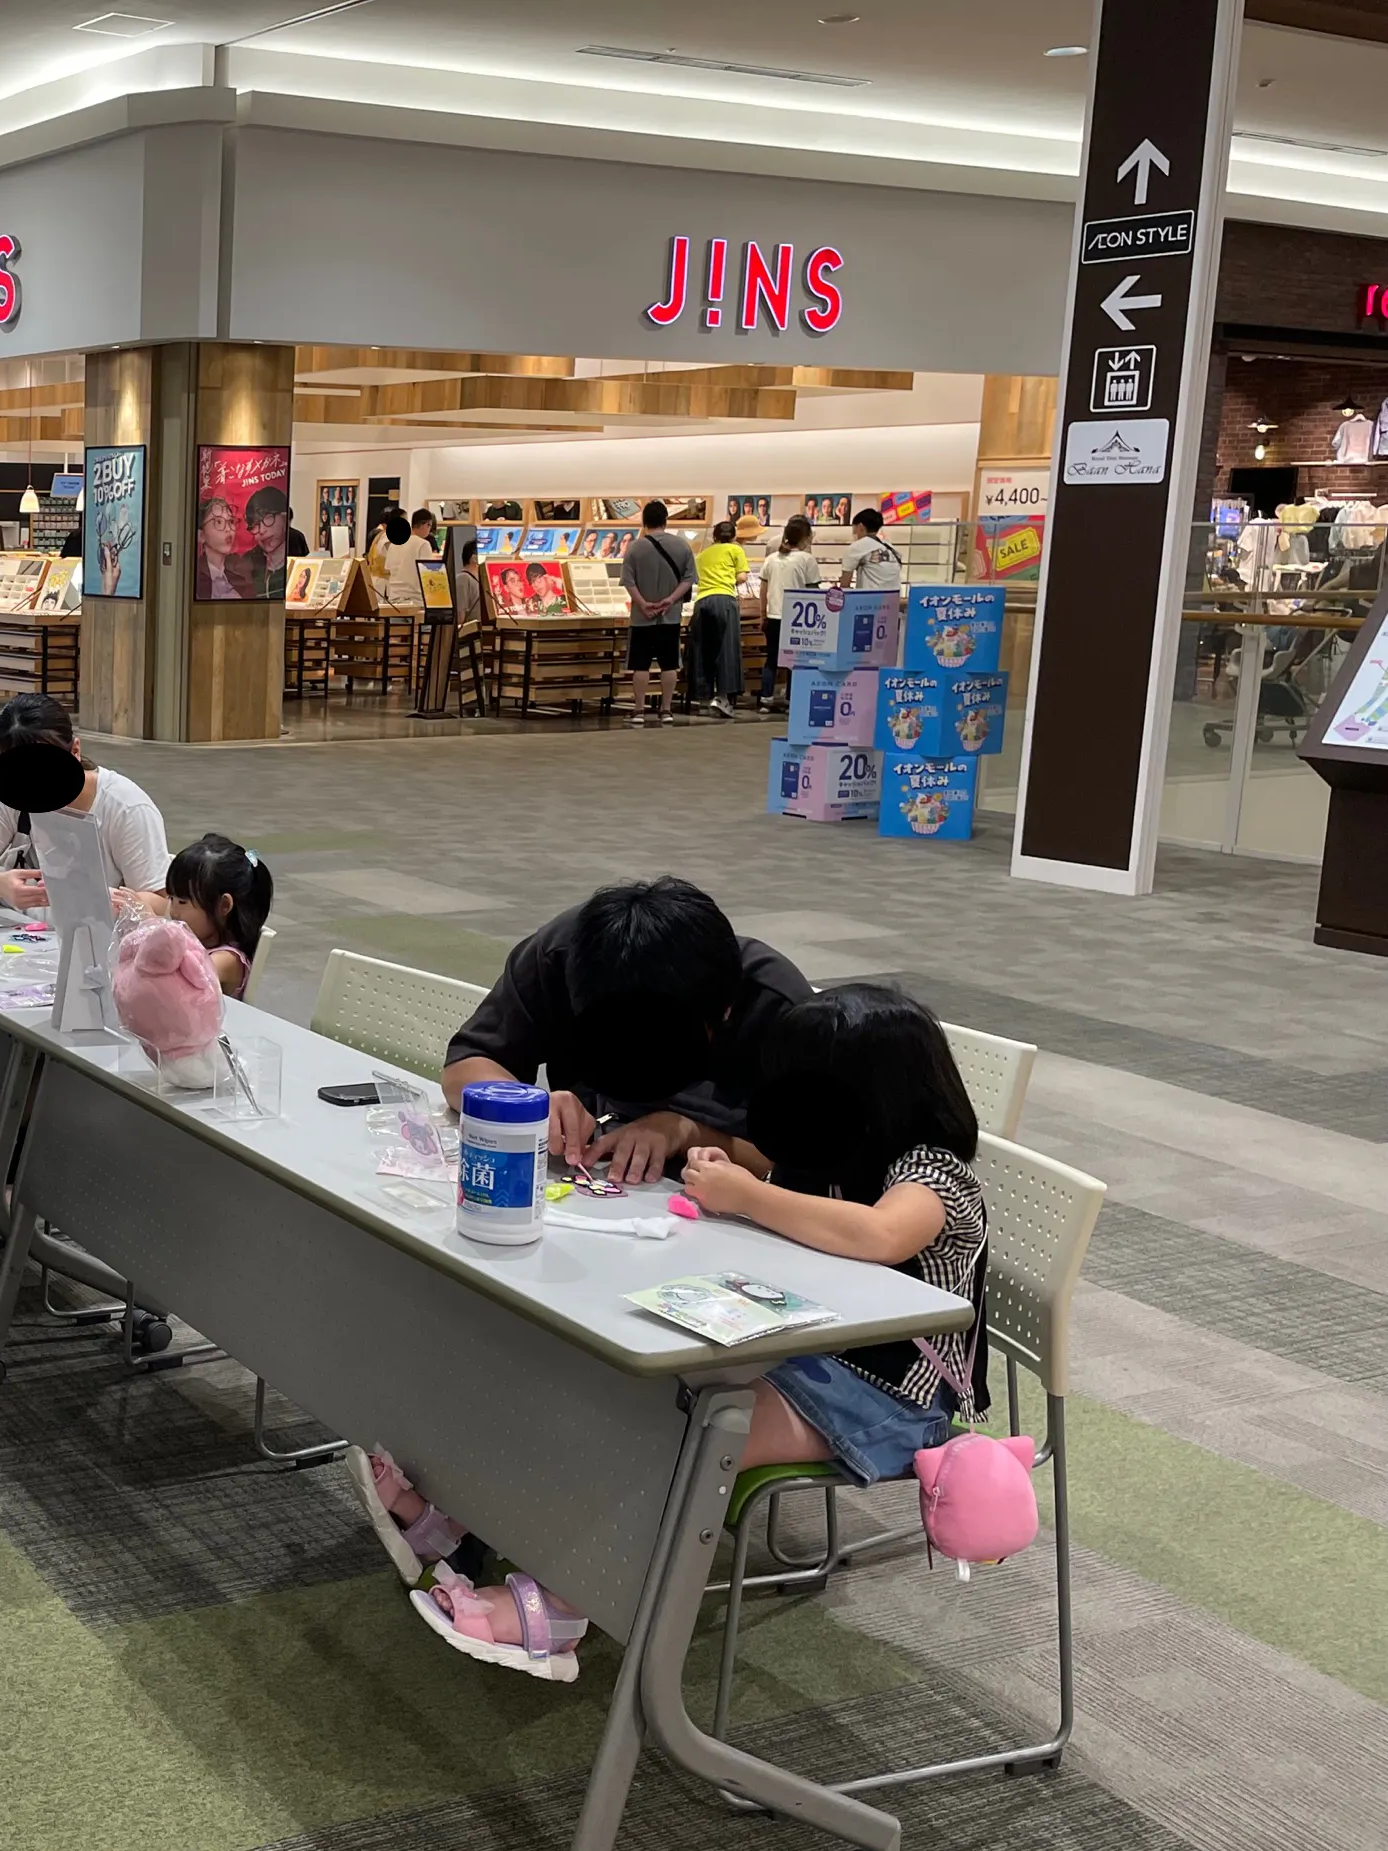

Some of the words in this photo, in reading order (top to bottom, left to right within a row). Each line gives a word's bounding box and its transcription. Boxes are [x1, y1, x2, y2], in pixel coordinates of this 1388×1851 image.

[1136, 225, 1188, 244] STYLE
[241, 475, 259, 488] JINS
[259, 468, 286, 482] TODAY
[999, 539, 1029, 559] SALE
[919, 592, 995, 607] イオンモールの
[791, 601, 827, 629] 20%
[935, 607, 977, 621] 夏休み
[884, 676, 938, 689] イオンモールの
[951, 676, 1003, 694] イオンモールの
[894, 689, 924, 702] 夏休み
[962, 689, 991, 705] 夏休み
[839, 754, 877, 781] 20%
[893, 763, 968, 776] イオンモールの
[909, 775, 949, 789] 夏休み
